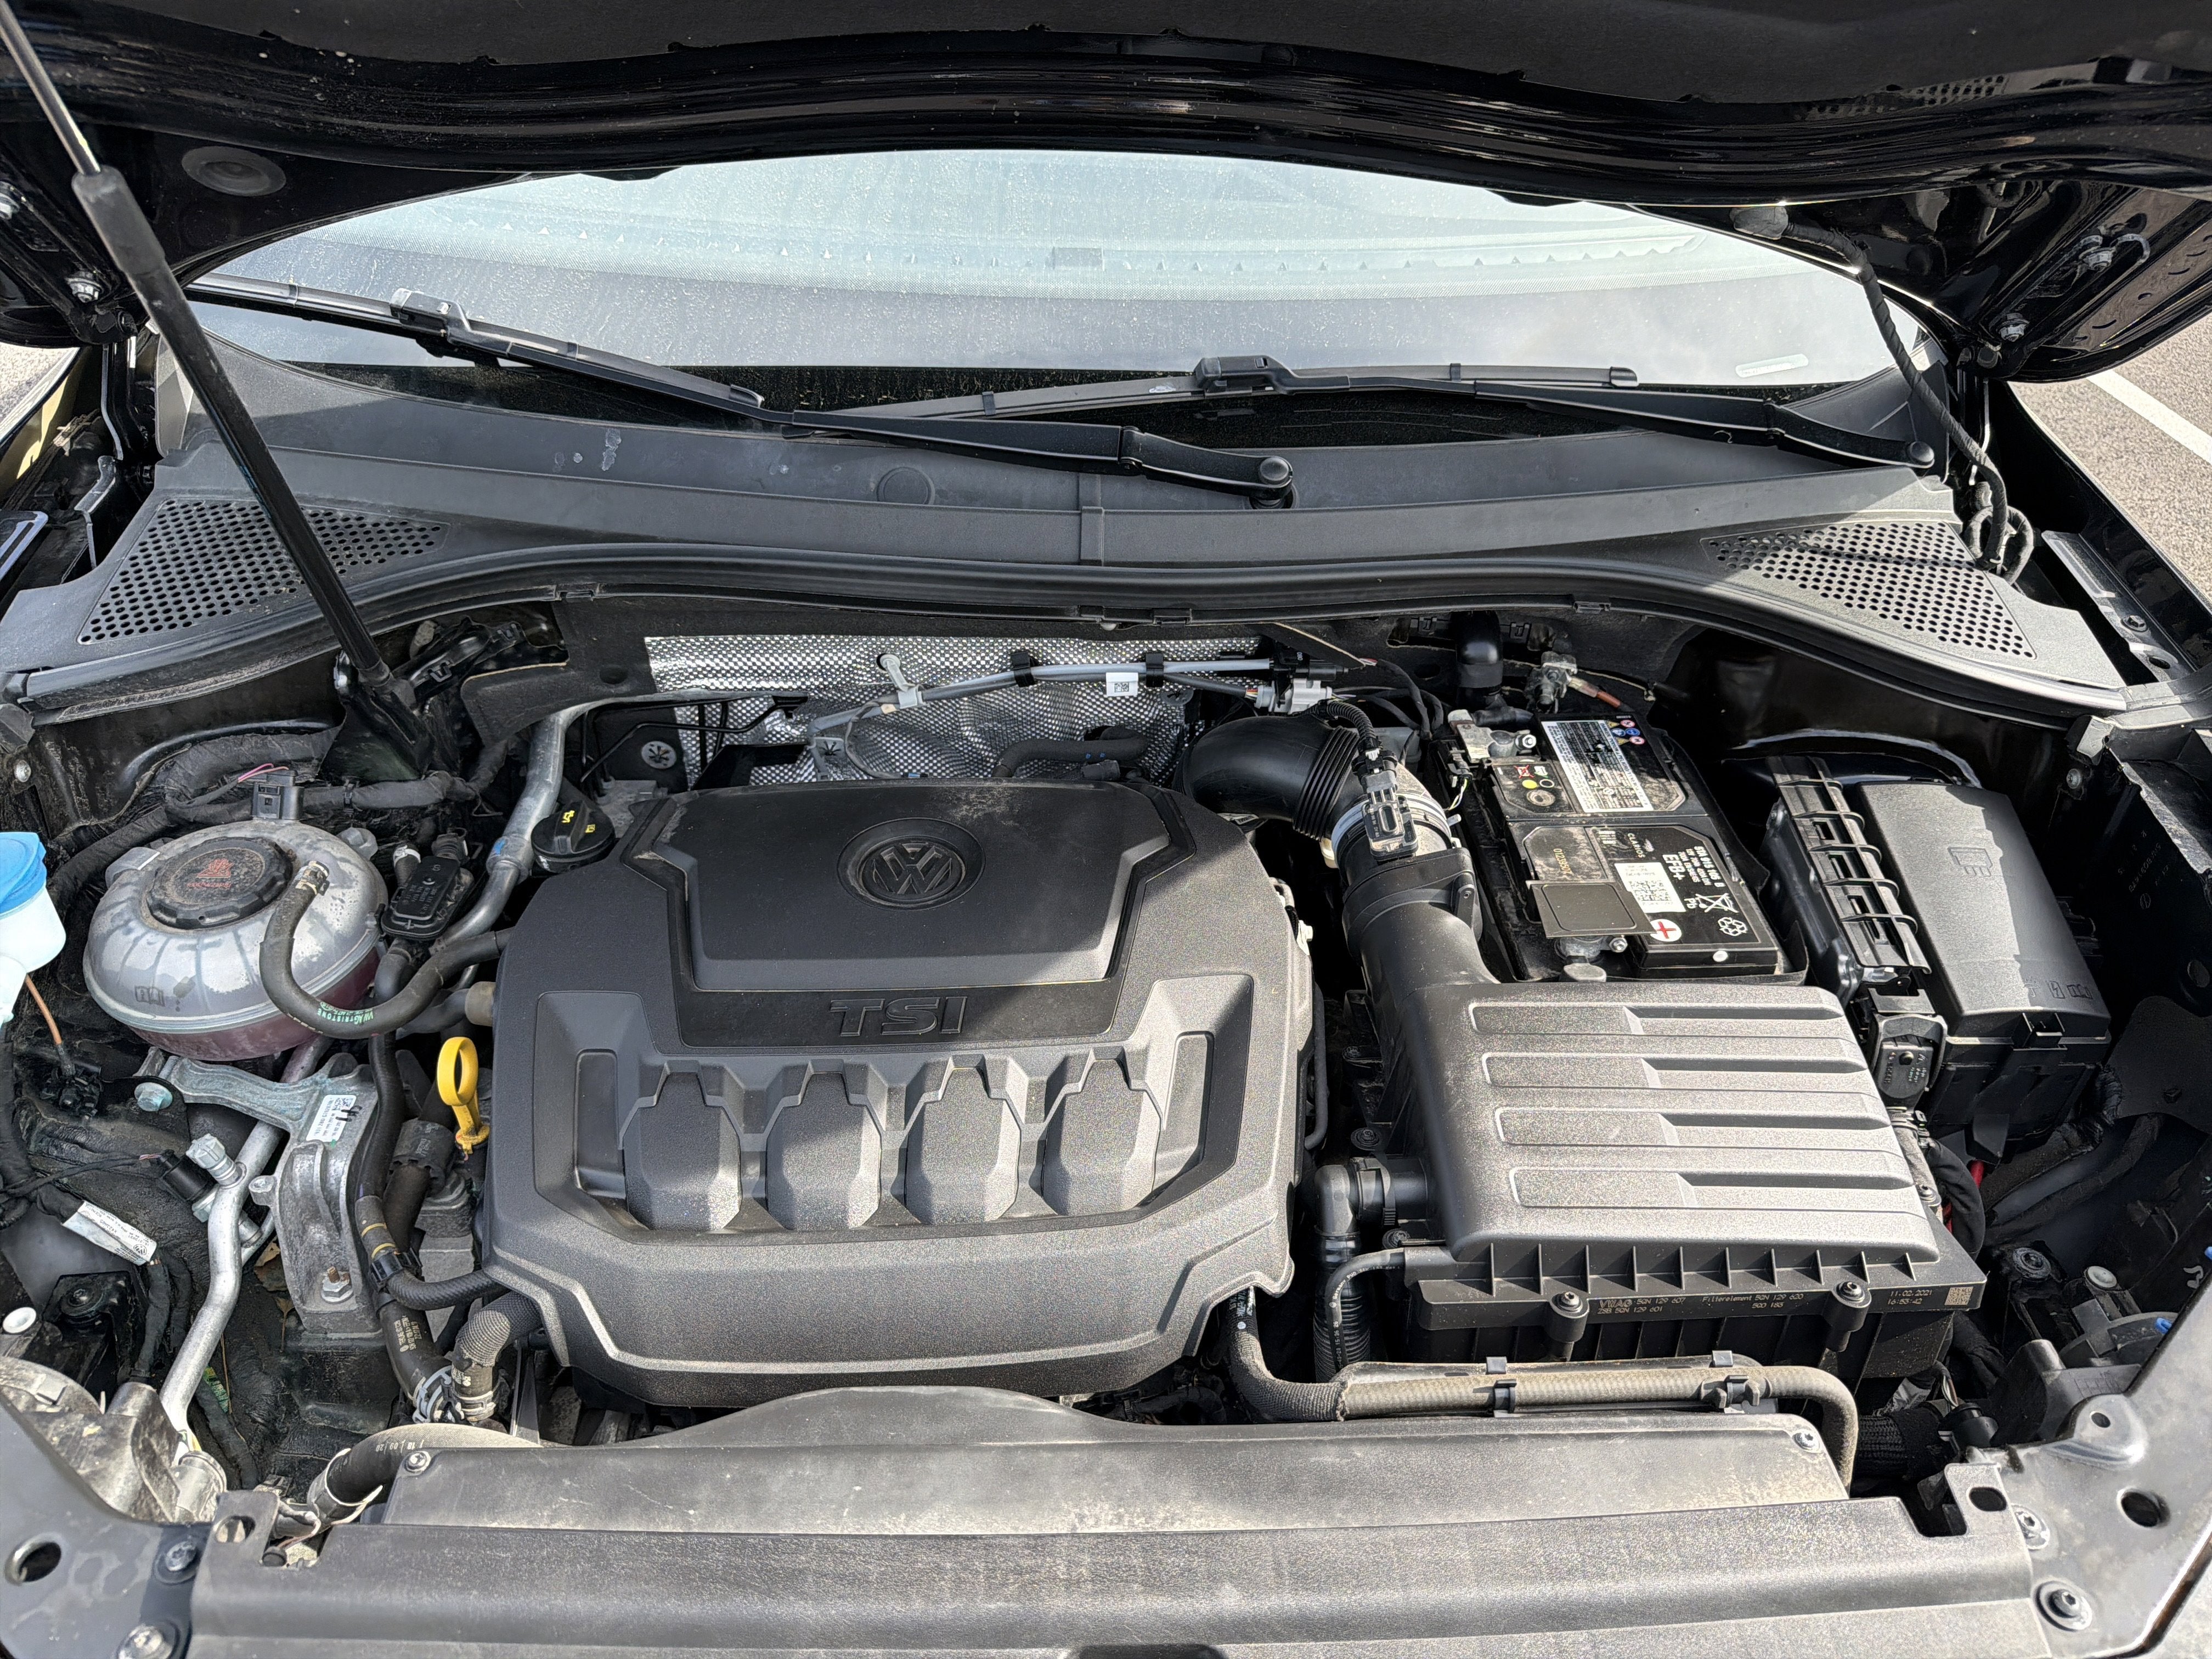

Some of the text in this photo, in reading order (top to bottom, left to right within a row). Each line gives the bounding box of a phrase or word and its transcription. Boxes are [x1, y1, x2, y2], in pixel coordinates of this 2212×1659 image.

[1627, 833, 1646, 858] CLARIOS
[1662, 854, 1685, 881] EFB+
[1700, 857, 1715, 868] 915
[1684, 898, 1698, 909] Pb
[830, 996, 968, 1037] TSI
